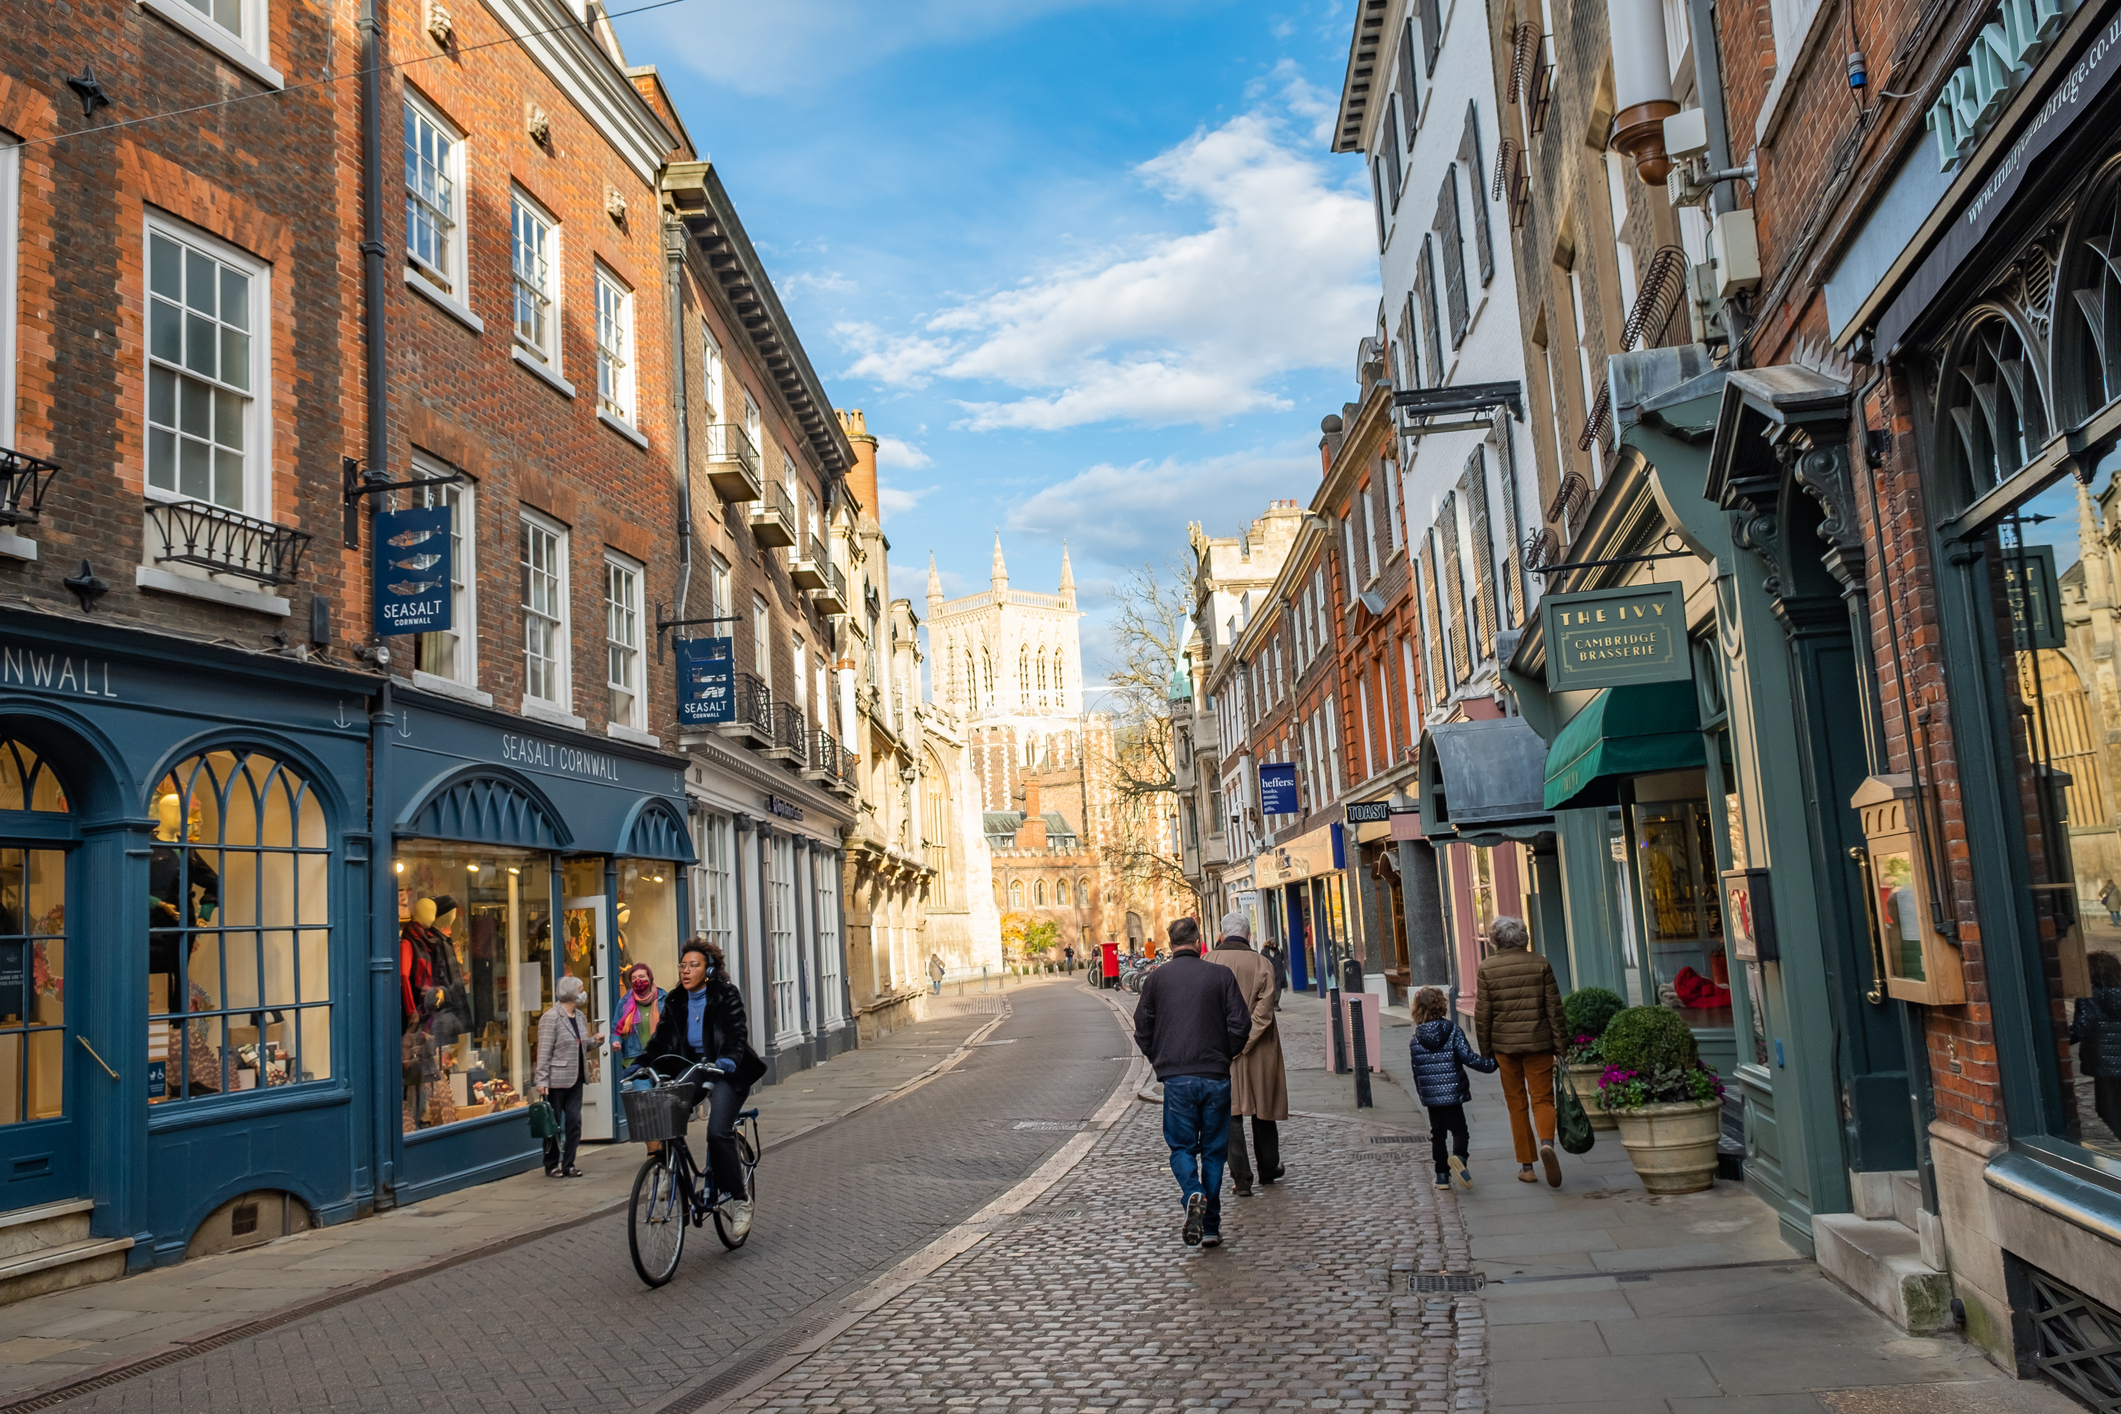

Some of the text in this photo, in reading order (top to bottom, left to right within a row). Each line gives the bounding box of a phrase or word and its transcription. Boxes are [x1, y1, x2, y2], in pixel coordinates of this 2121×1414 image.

[1967, 8, 2121, 225] www.trinitycambridge.co.u
[384, 600, 442, 618] SEASALT
[1560, 602, 1666, 626] THE IVY
[394, 617, 432, 627] CORNWALL
[1575, 632, 1657, 650] CAMBRIDGE
[1579, 644, 1656, 662] BRASSERIE
[684, 700, 727, 714] SEASALT
[502, 733, 619, 781] SEASALT CORNWALL
[1262, 777, 1294, 787] heffers:
[1347, 803, 1388, 821] TOAST
